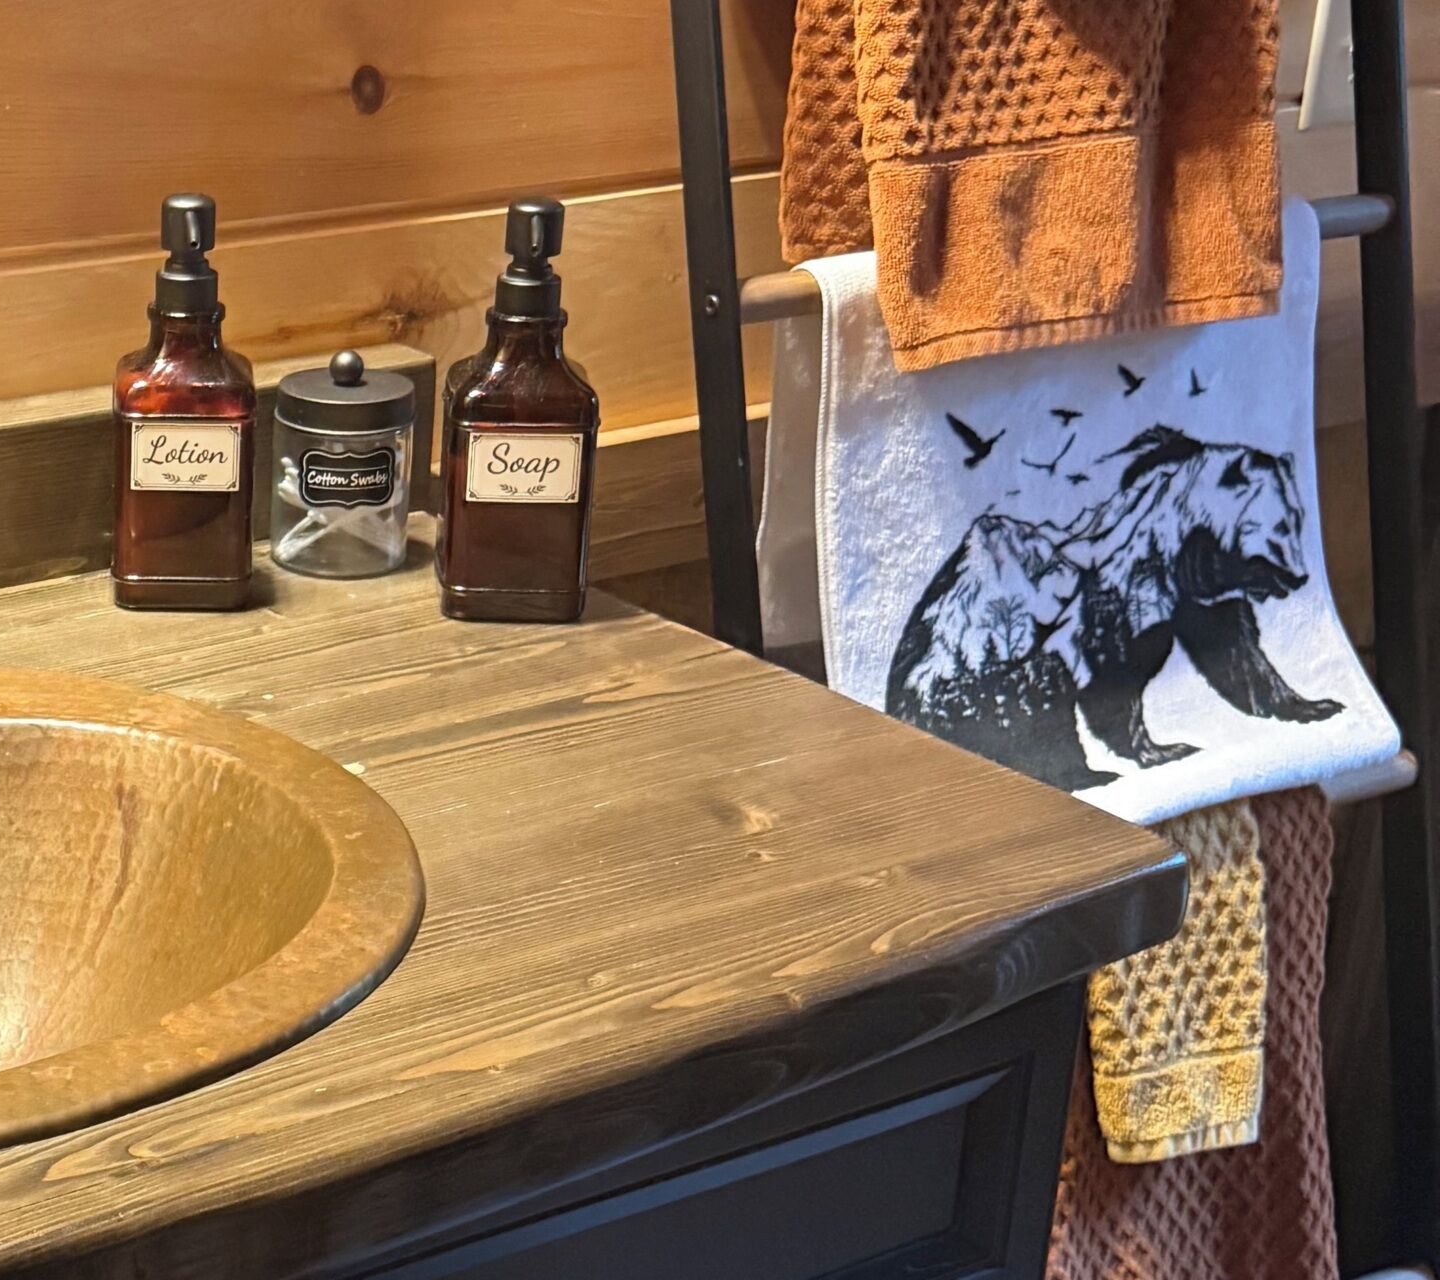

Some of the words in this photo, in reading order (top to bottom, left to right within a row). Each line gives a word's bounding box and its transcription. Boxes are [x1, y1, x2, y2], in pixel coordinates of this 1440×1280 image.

[142, 434, 228, 465] Lotion
[487, 442, 561, 483] Soap
[307, 470, 348, 487] Cotton
[350, 470, 388, 487] Swabs
